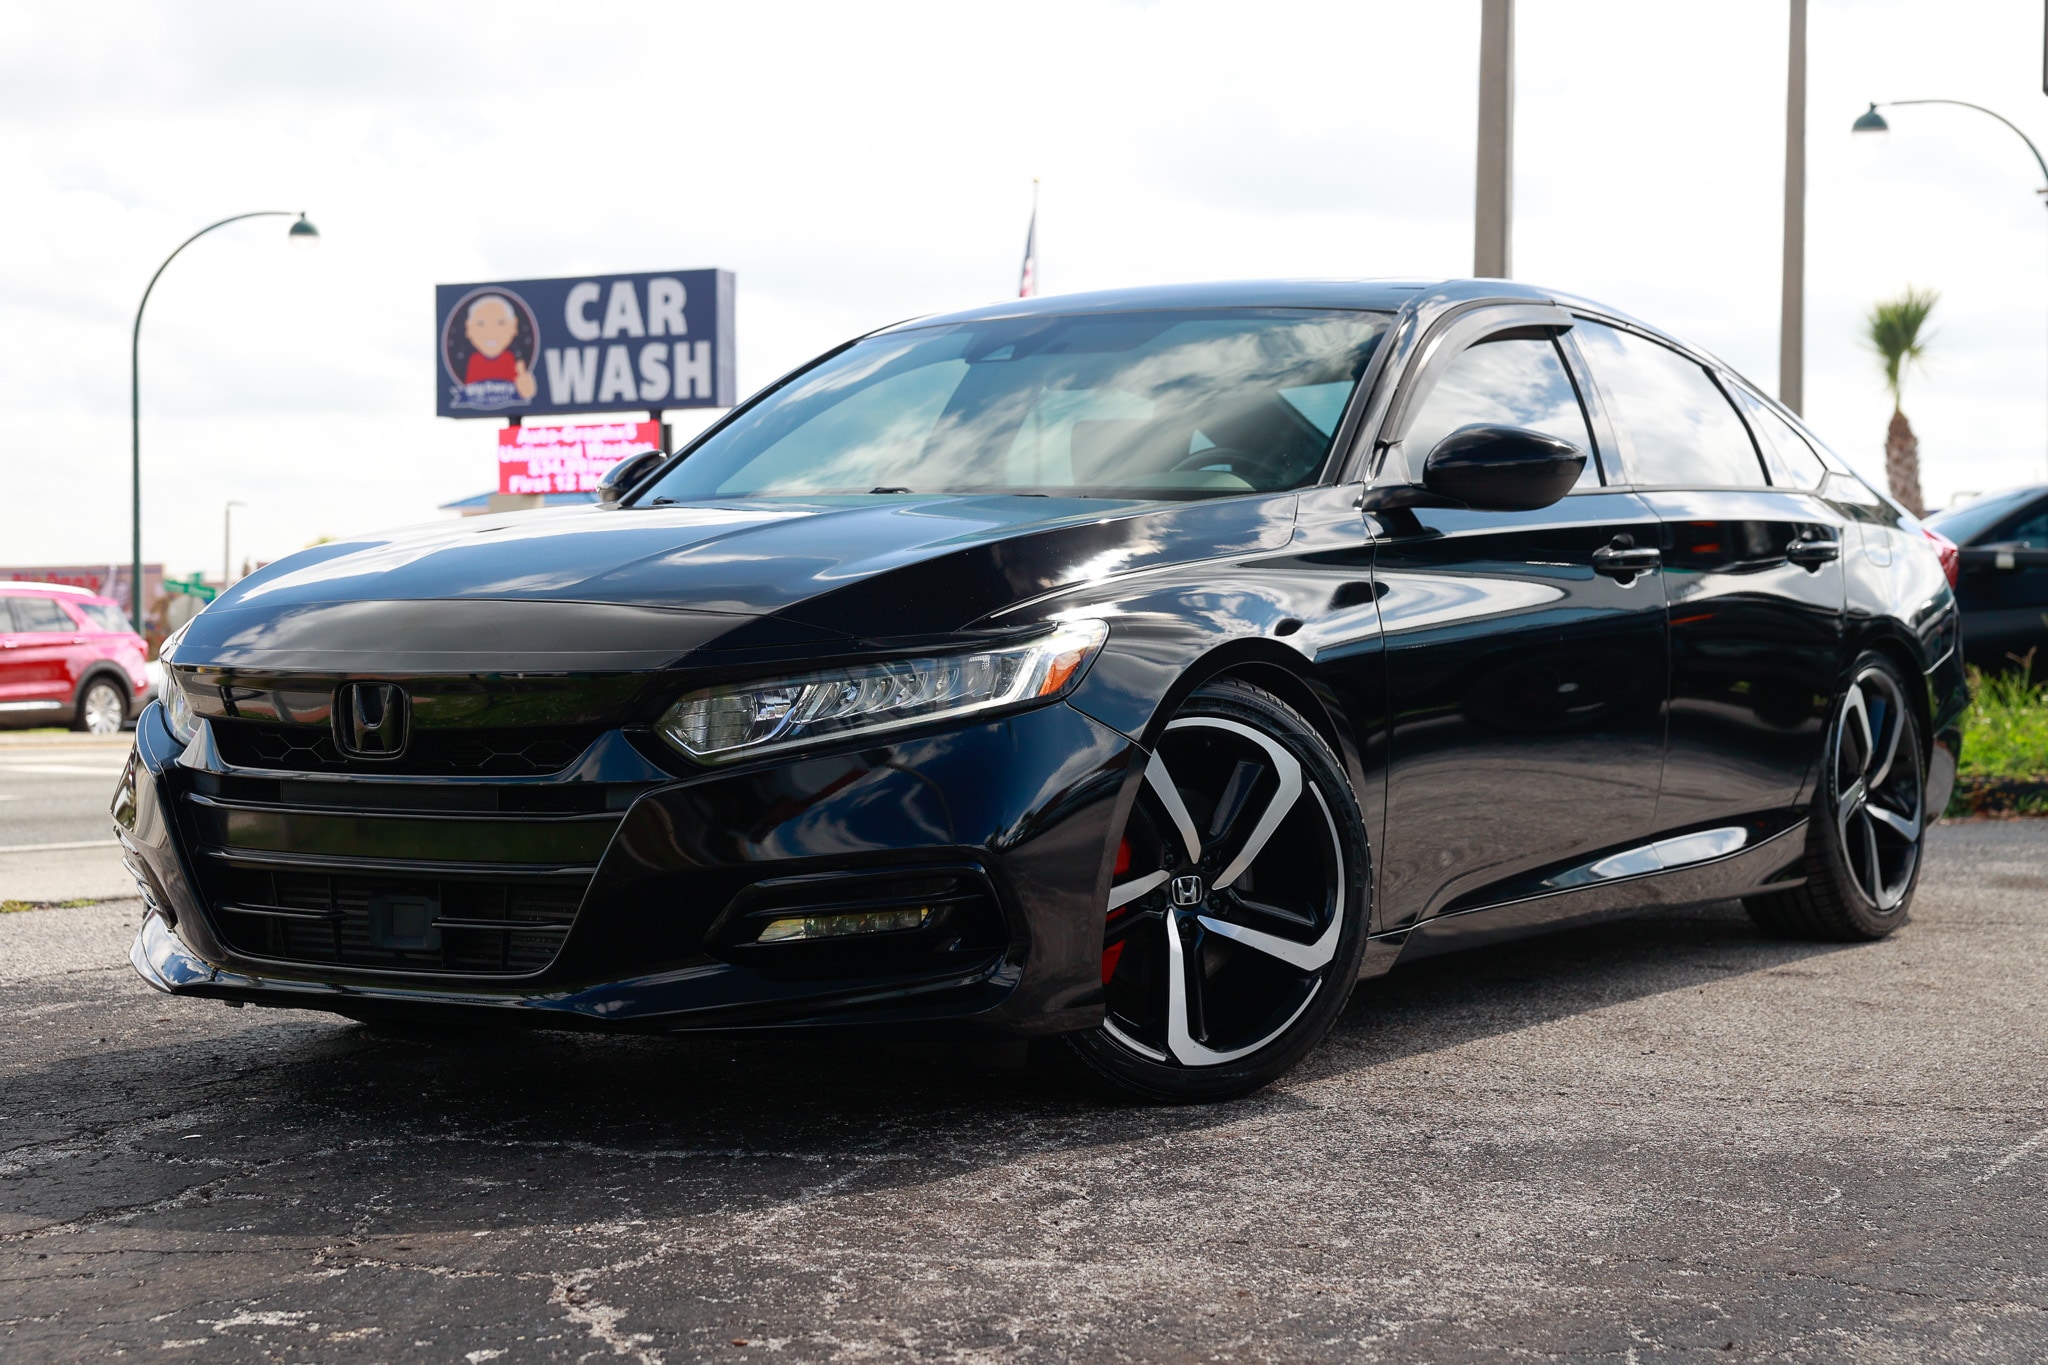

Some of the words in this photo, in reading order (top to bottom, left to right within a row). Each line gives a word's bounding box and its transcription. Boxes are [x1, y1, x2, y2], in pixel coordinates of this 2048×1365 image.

[565, 277, 688, 341] CAR
[544, 341, 711, 404] WASH
[499, 443, 583, 462] Unlimited
[509, 474, 551, 493] First
